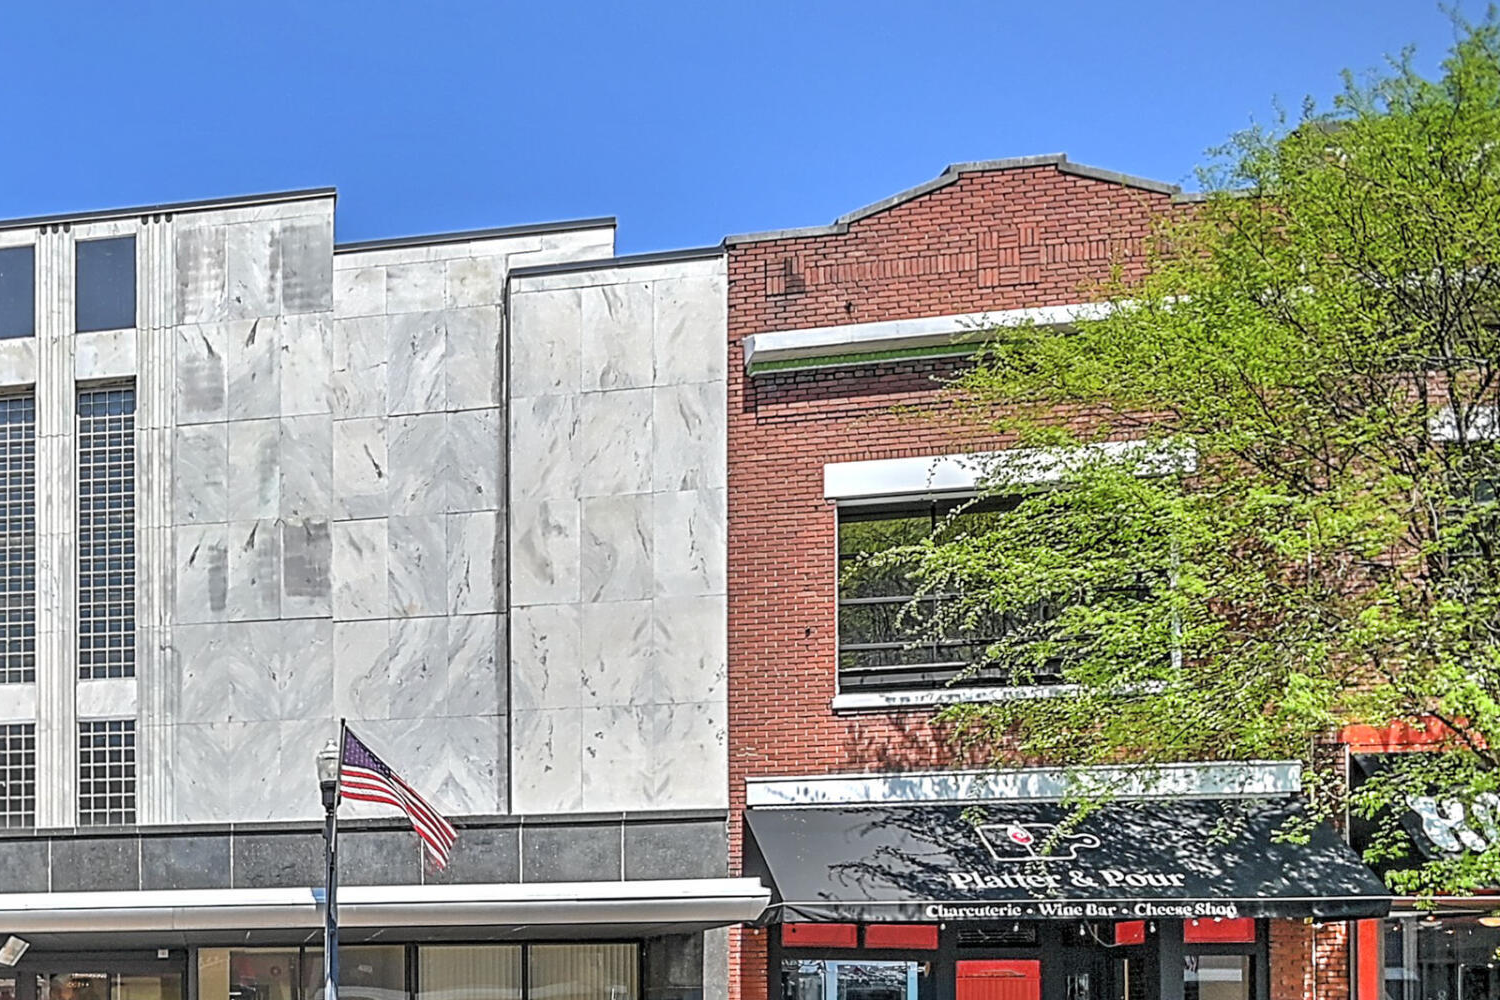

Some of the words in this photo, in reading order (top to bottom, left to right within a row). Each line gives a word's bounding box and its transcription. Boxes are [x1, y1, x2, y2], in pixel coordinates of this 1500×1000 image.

[949, 871, 1062, 891] Platter
[1070, 869, 1100, 889] &
[1098, 869, 1185, 888] Pour
[925, 903, 1022, 918] Charcuterie
[1037, 903, 1083, 917] Wine
[1086, 903, 1117, 917] Bar
[1134, 903, 1192, 917] Cheese
[1194, 902, 1238, 918] Shop
